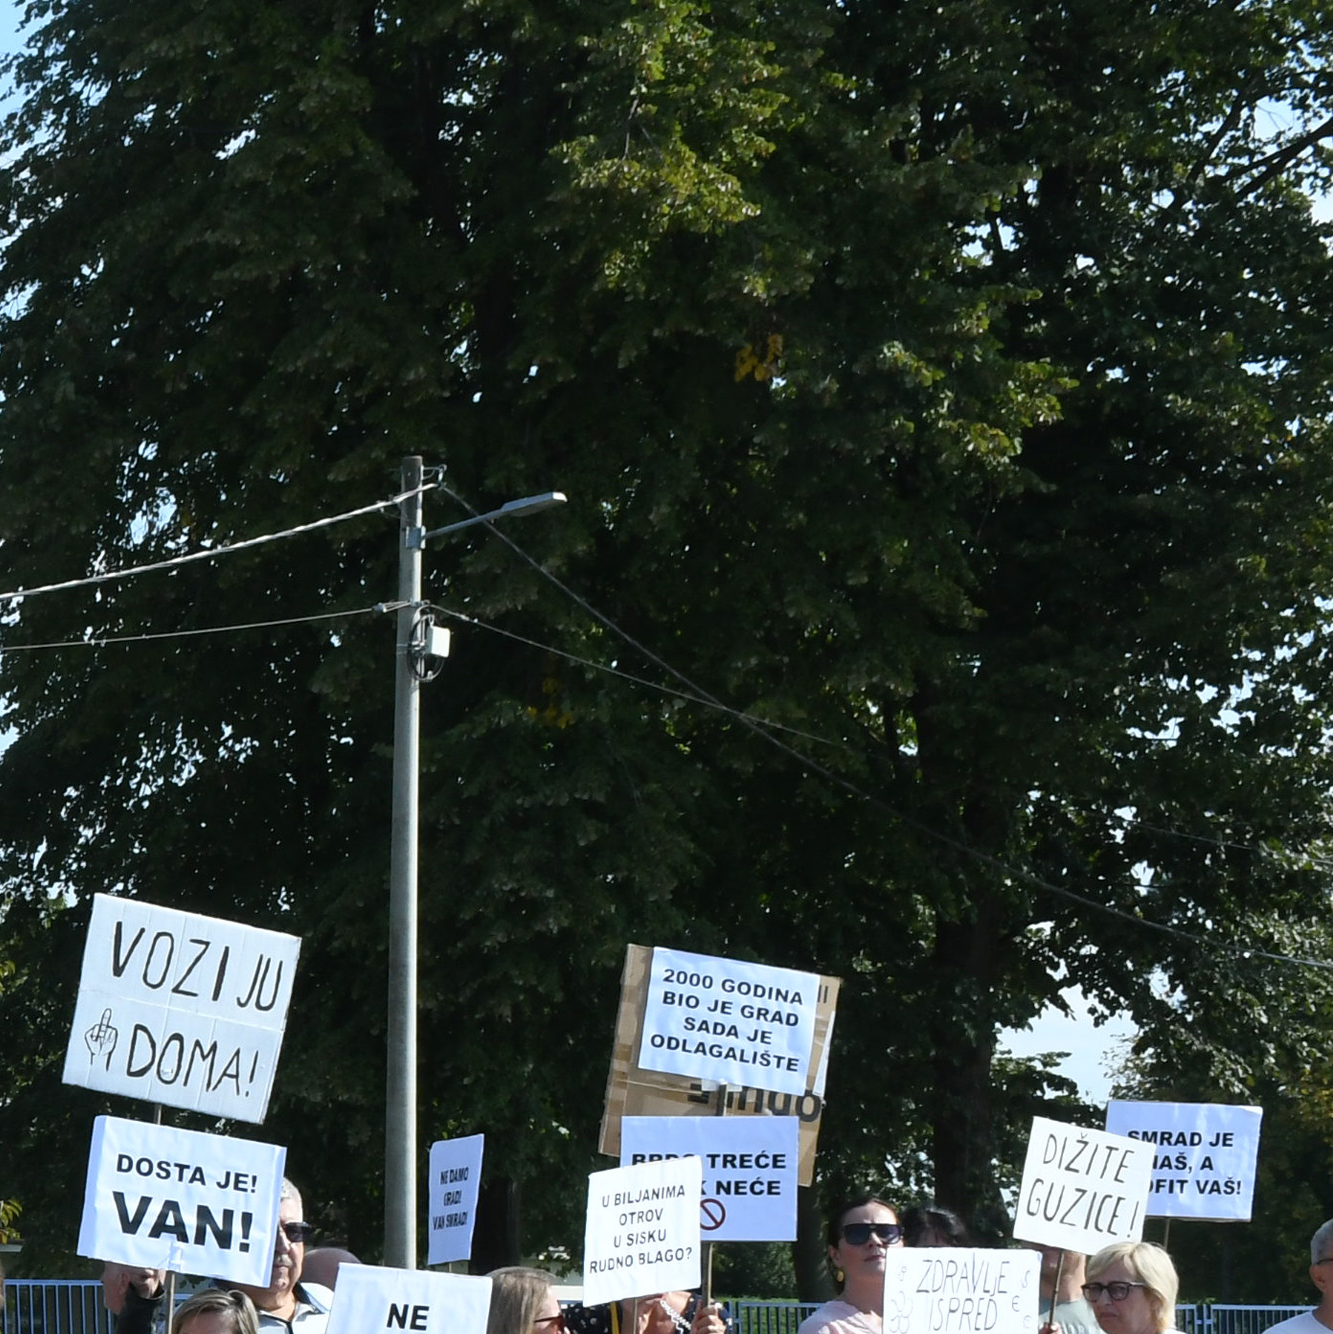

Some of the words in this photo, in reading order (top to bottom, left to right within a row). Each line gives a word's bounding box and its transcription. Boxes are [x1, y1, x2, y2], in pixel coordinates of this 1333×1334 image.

[112, 921, 229, 1002] VOZI
[237, 954, 284, 1011] JU
[662, 968, 714, 990] 2000
[720, 978, 803, 1006] GODINA
[662, 990, 700, 1009] BIO
[708, 998, 733, 1015] JE
[740, 1002, 800, 1028] GRAD
[683, 1016, 739, 1039] SADA
[747, 1027, 773, 1045] JE
[126, 1023, 258, 1097] DOMA!
[650, 1033, 800, 1072] ODLAGALIŠTE
[1209, 1133, 1234, 1147] JE
[706, 1150, 787, 1169] TREĆE
[1043, 1133, 1135, 1183] DIŽITE
[1200, 1156, 1214, 1171] A
[117, 1154, 205, 1186] DOSTA
[216, 1170, 258, 1194] JE!
[716, 1177, 781, 1196] NEĆE
[1149, 1179, 1188, 1194] FIT
[1196, 1177, 1241, 1195] VAŠ!
[601, 1195, 609, 1208] U
[614, 1184, 685, 1207] BILJANIMA
[112, 1191, 253, 1253] VAN!
[619, 1208, 663, 1226] OTROV
[614, 1235, 621, 1248] U
[626, 1229, 667, 1246] SISKU
[589, 1255, 633, 1275] RUDNO
[638, 1247, 693, 1267] BLAGO?
[386, 1302, 429, 1331] NE
[928, 1297, 998, 1332] ISPRED
